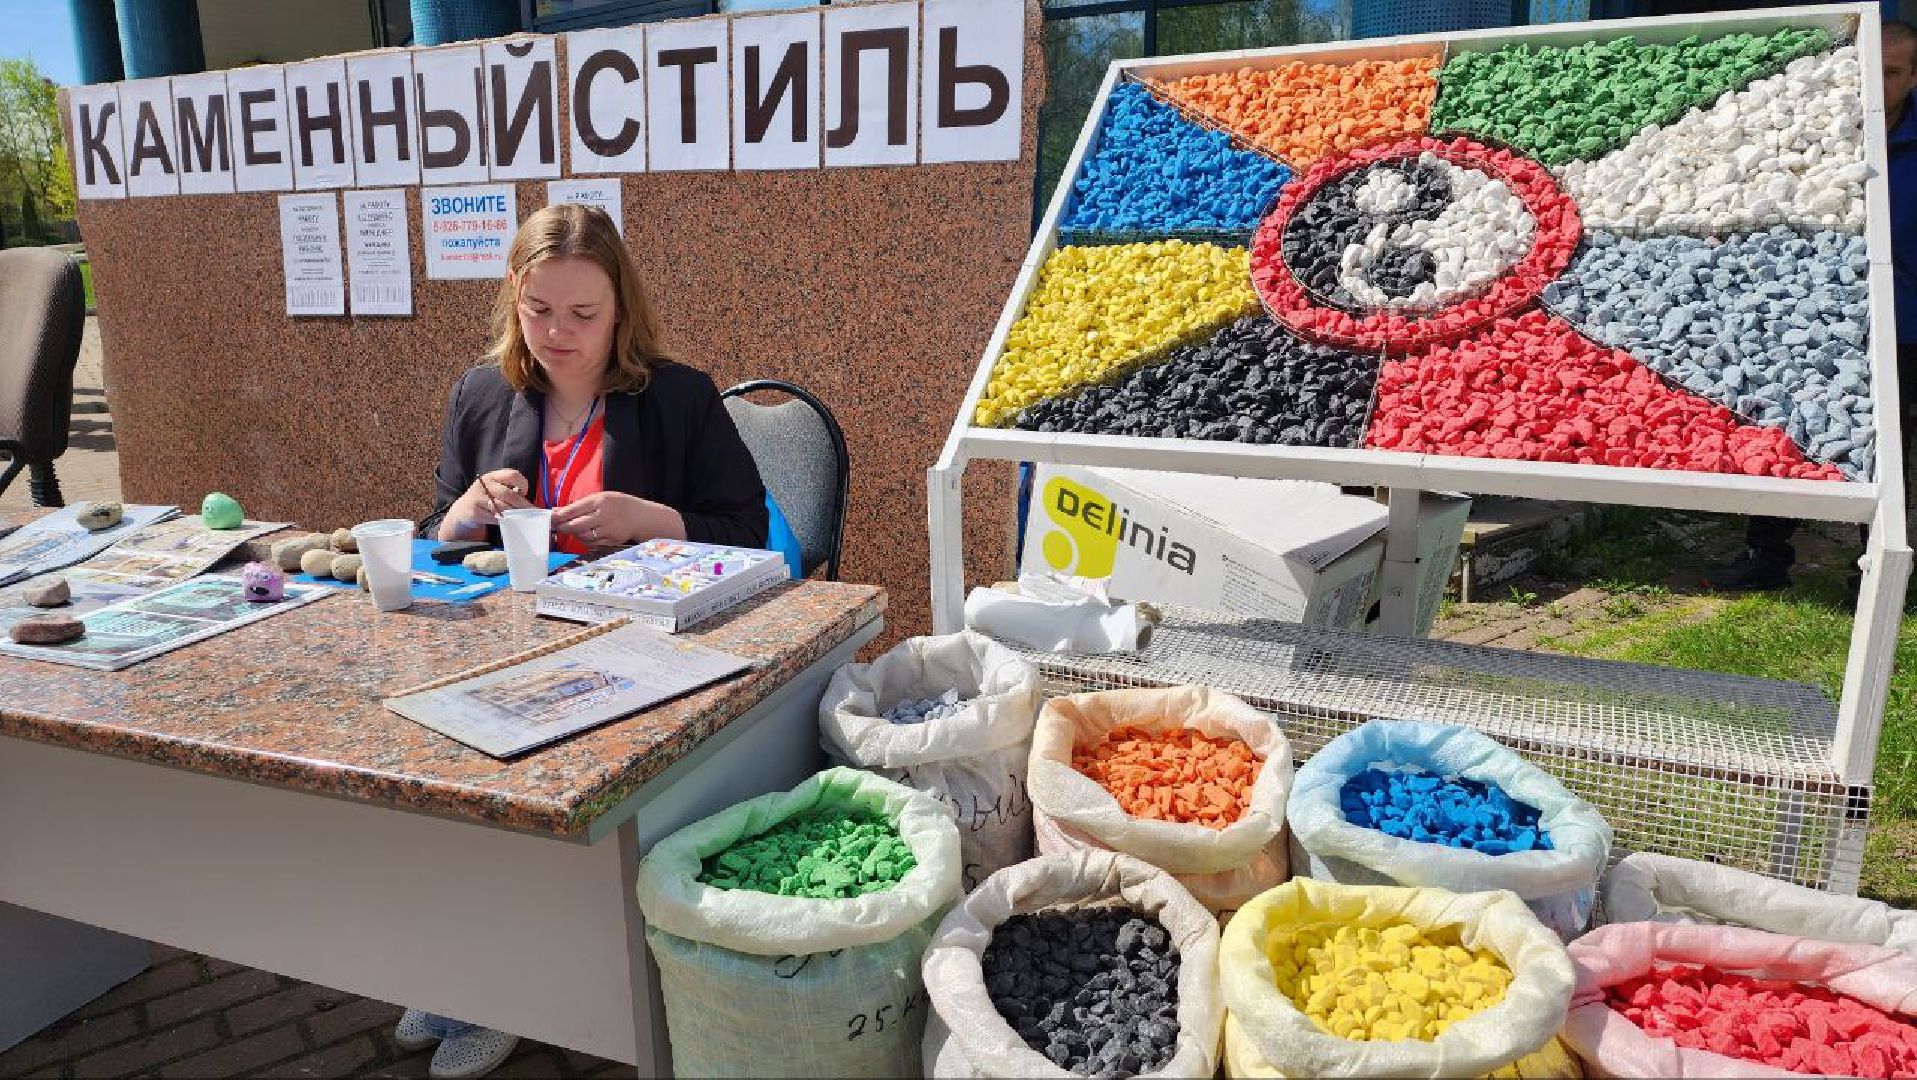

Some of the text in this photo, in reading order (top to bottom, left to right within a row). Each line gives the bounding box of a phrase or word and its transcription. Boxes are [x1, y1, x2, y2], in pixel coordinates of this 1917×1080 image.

[79, 26, 1011, 186] КАМЕННЫЙ СТИЛЬ
[431, 195, 507, 215] ЗВОНИТЕ
[442, 236, 501, 250] пожалуйста
